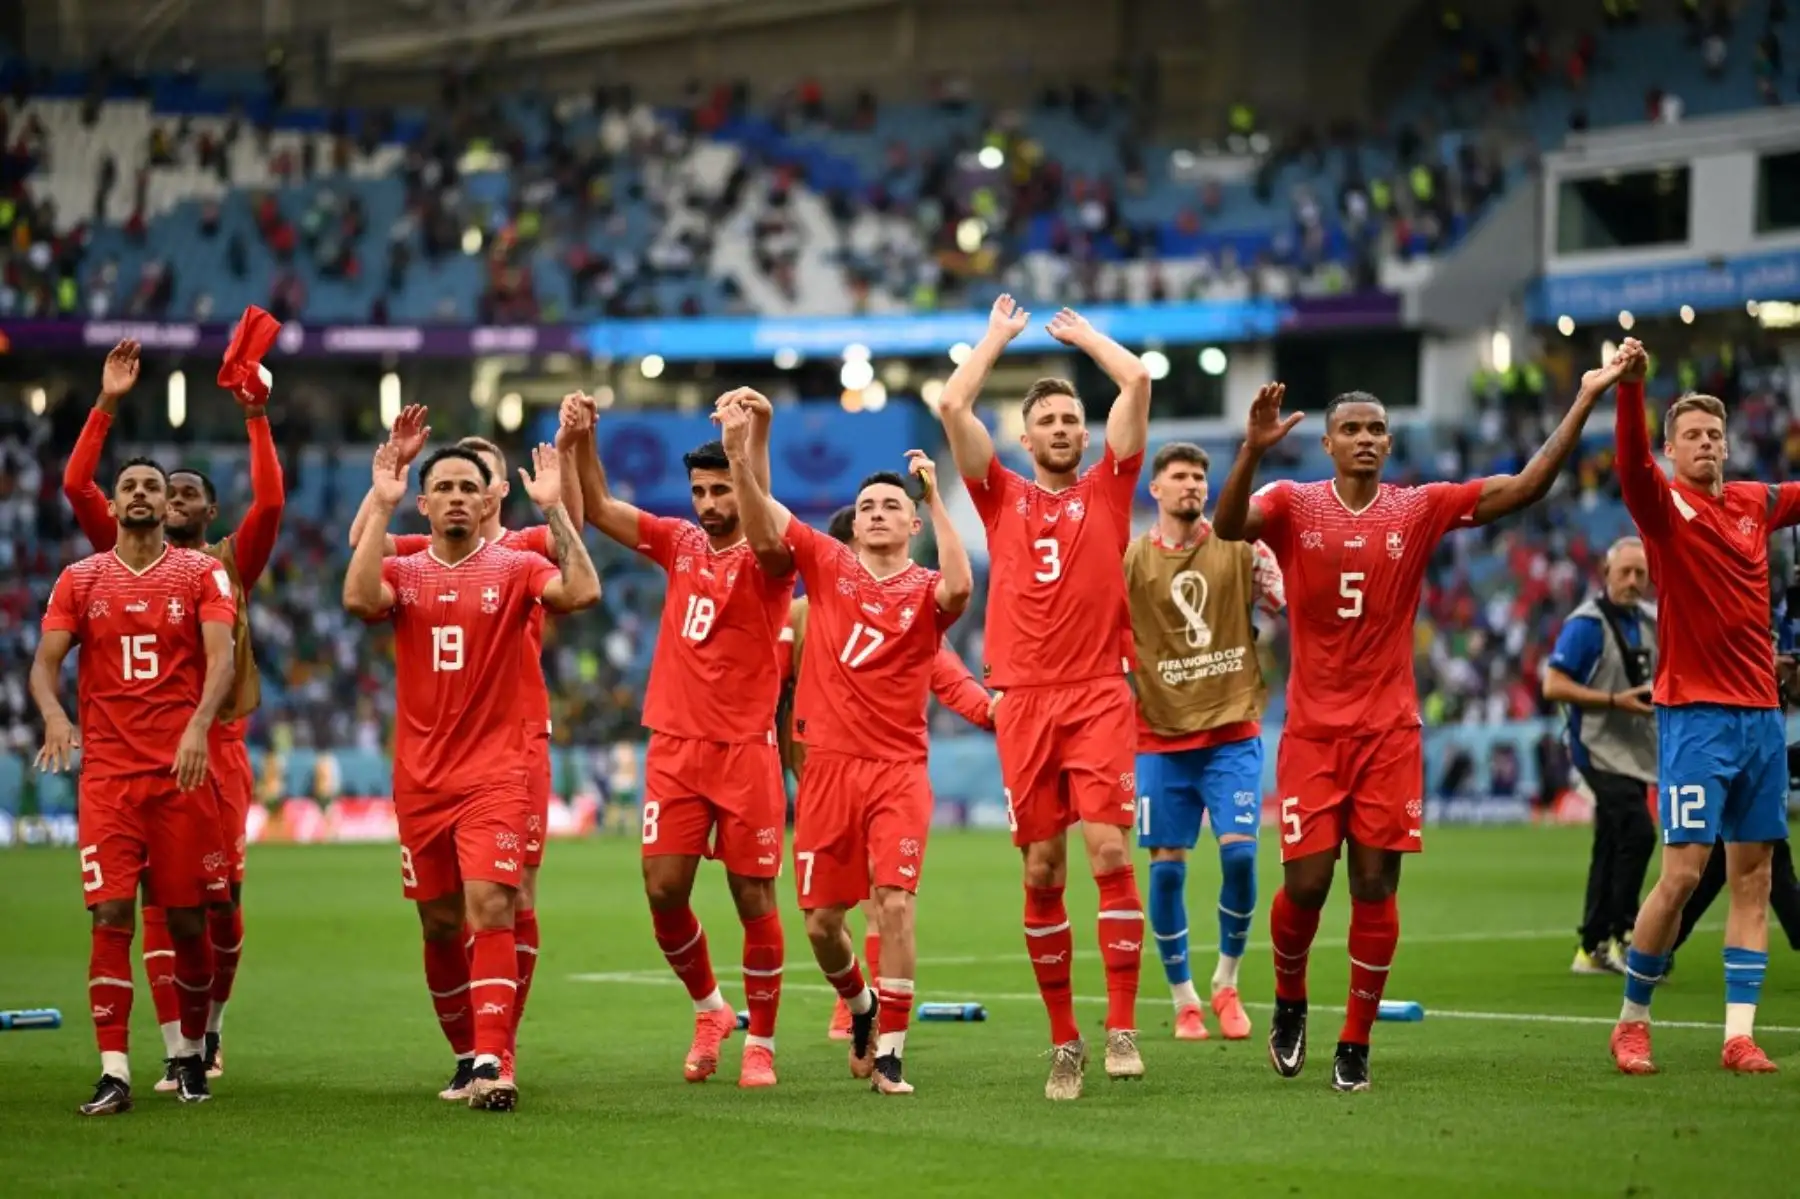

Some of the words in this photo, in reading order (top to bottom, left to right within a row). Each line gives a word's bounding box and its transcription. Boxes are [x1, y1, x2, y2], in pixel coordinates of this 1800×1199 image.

[1034, 538, 1061, 582] 3
[681, 593, 715, 641] 18
[1337, 572, 1365, 618] 5
[121, 634, 159, 680] 15
[432, 625, 464, 672] 19
[839, 622, 884, 668] 17
[1157, 659, 1183, 673] FIFA
[1182, 650, 1223, 669] WORLD
[1224, 646, 1246, 660] CUP
[642, 801, 660, 844] 8
[1281, 796, 1303, 844] 5
[1669, 785, 1706, 829] 12
[80, 845, 104, 892] 5
[797, 852, 815, 895] 7
